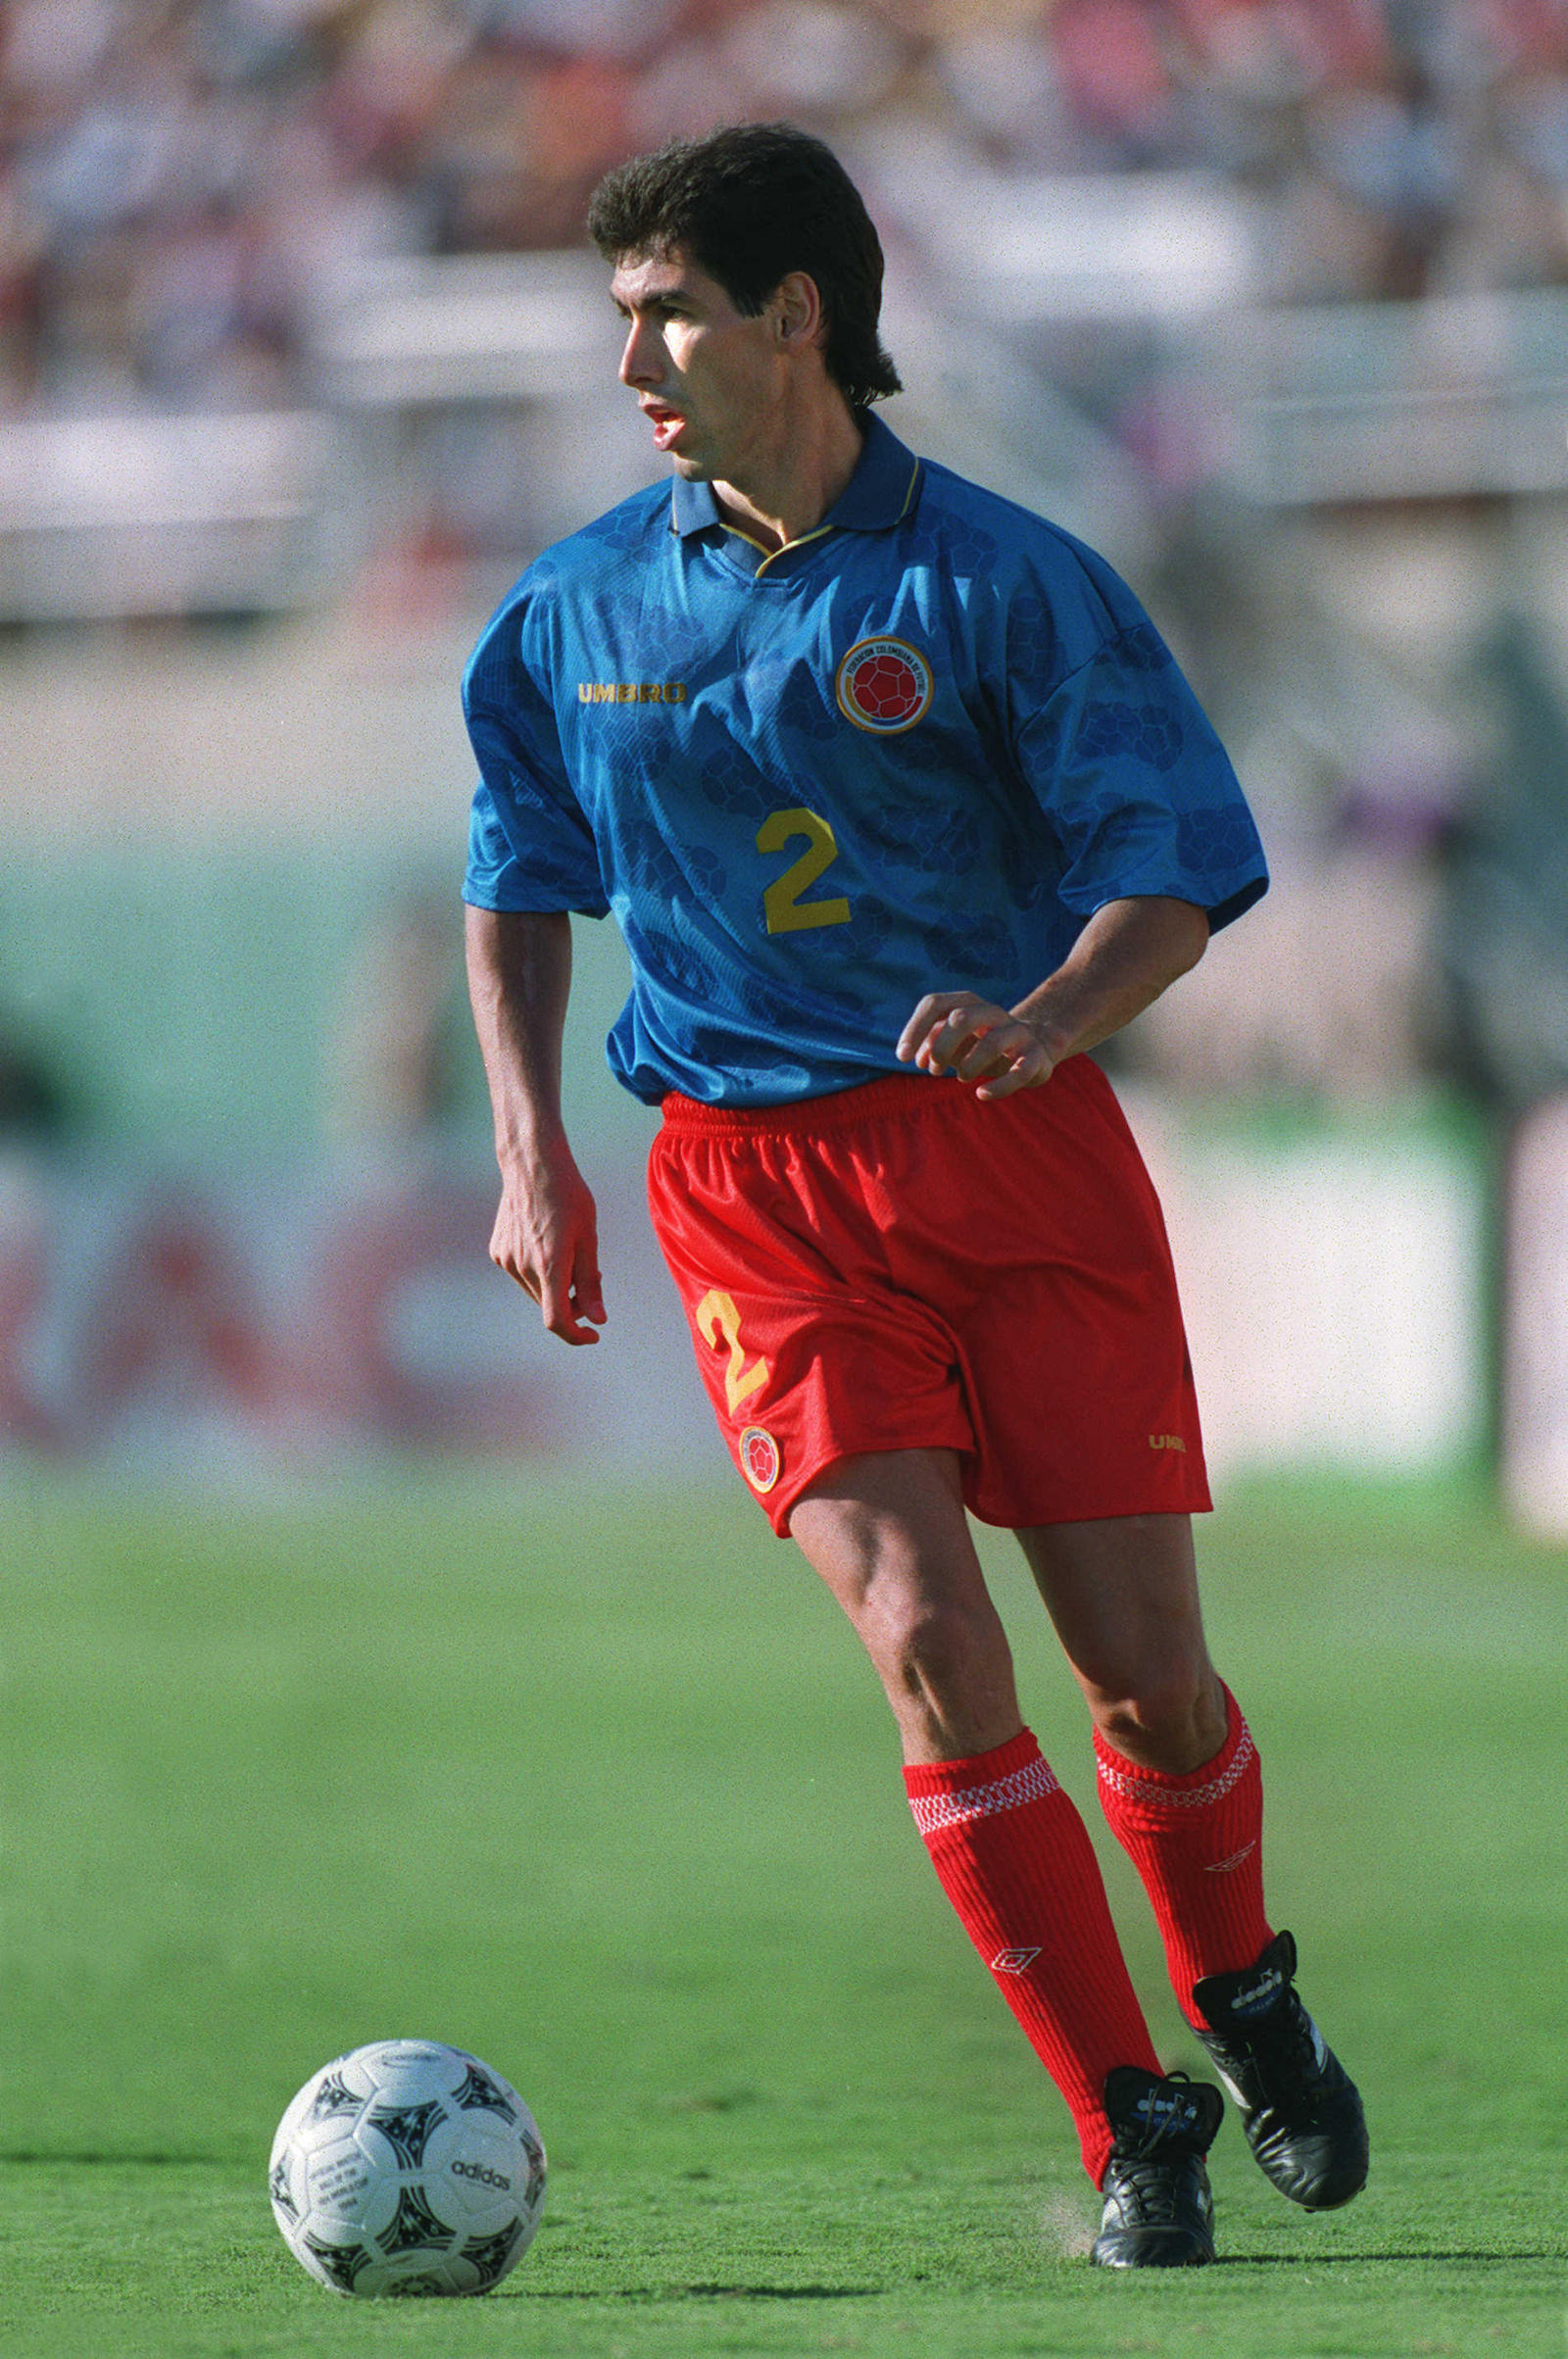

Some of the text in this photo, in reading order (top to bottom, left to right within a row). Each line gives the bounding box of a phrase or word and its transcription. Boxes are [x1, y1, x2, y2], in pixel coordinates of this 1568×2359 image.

[578, 682, 687, 704] UMBRO
[755, 808, 852, 935] 2
[696, 1289, 769, 1418] 2
[451, 2160, 511, 2191] adidas
